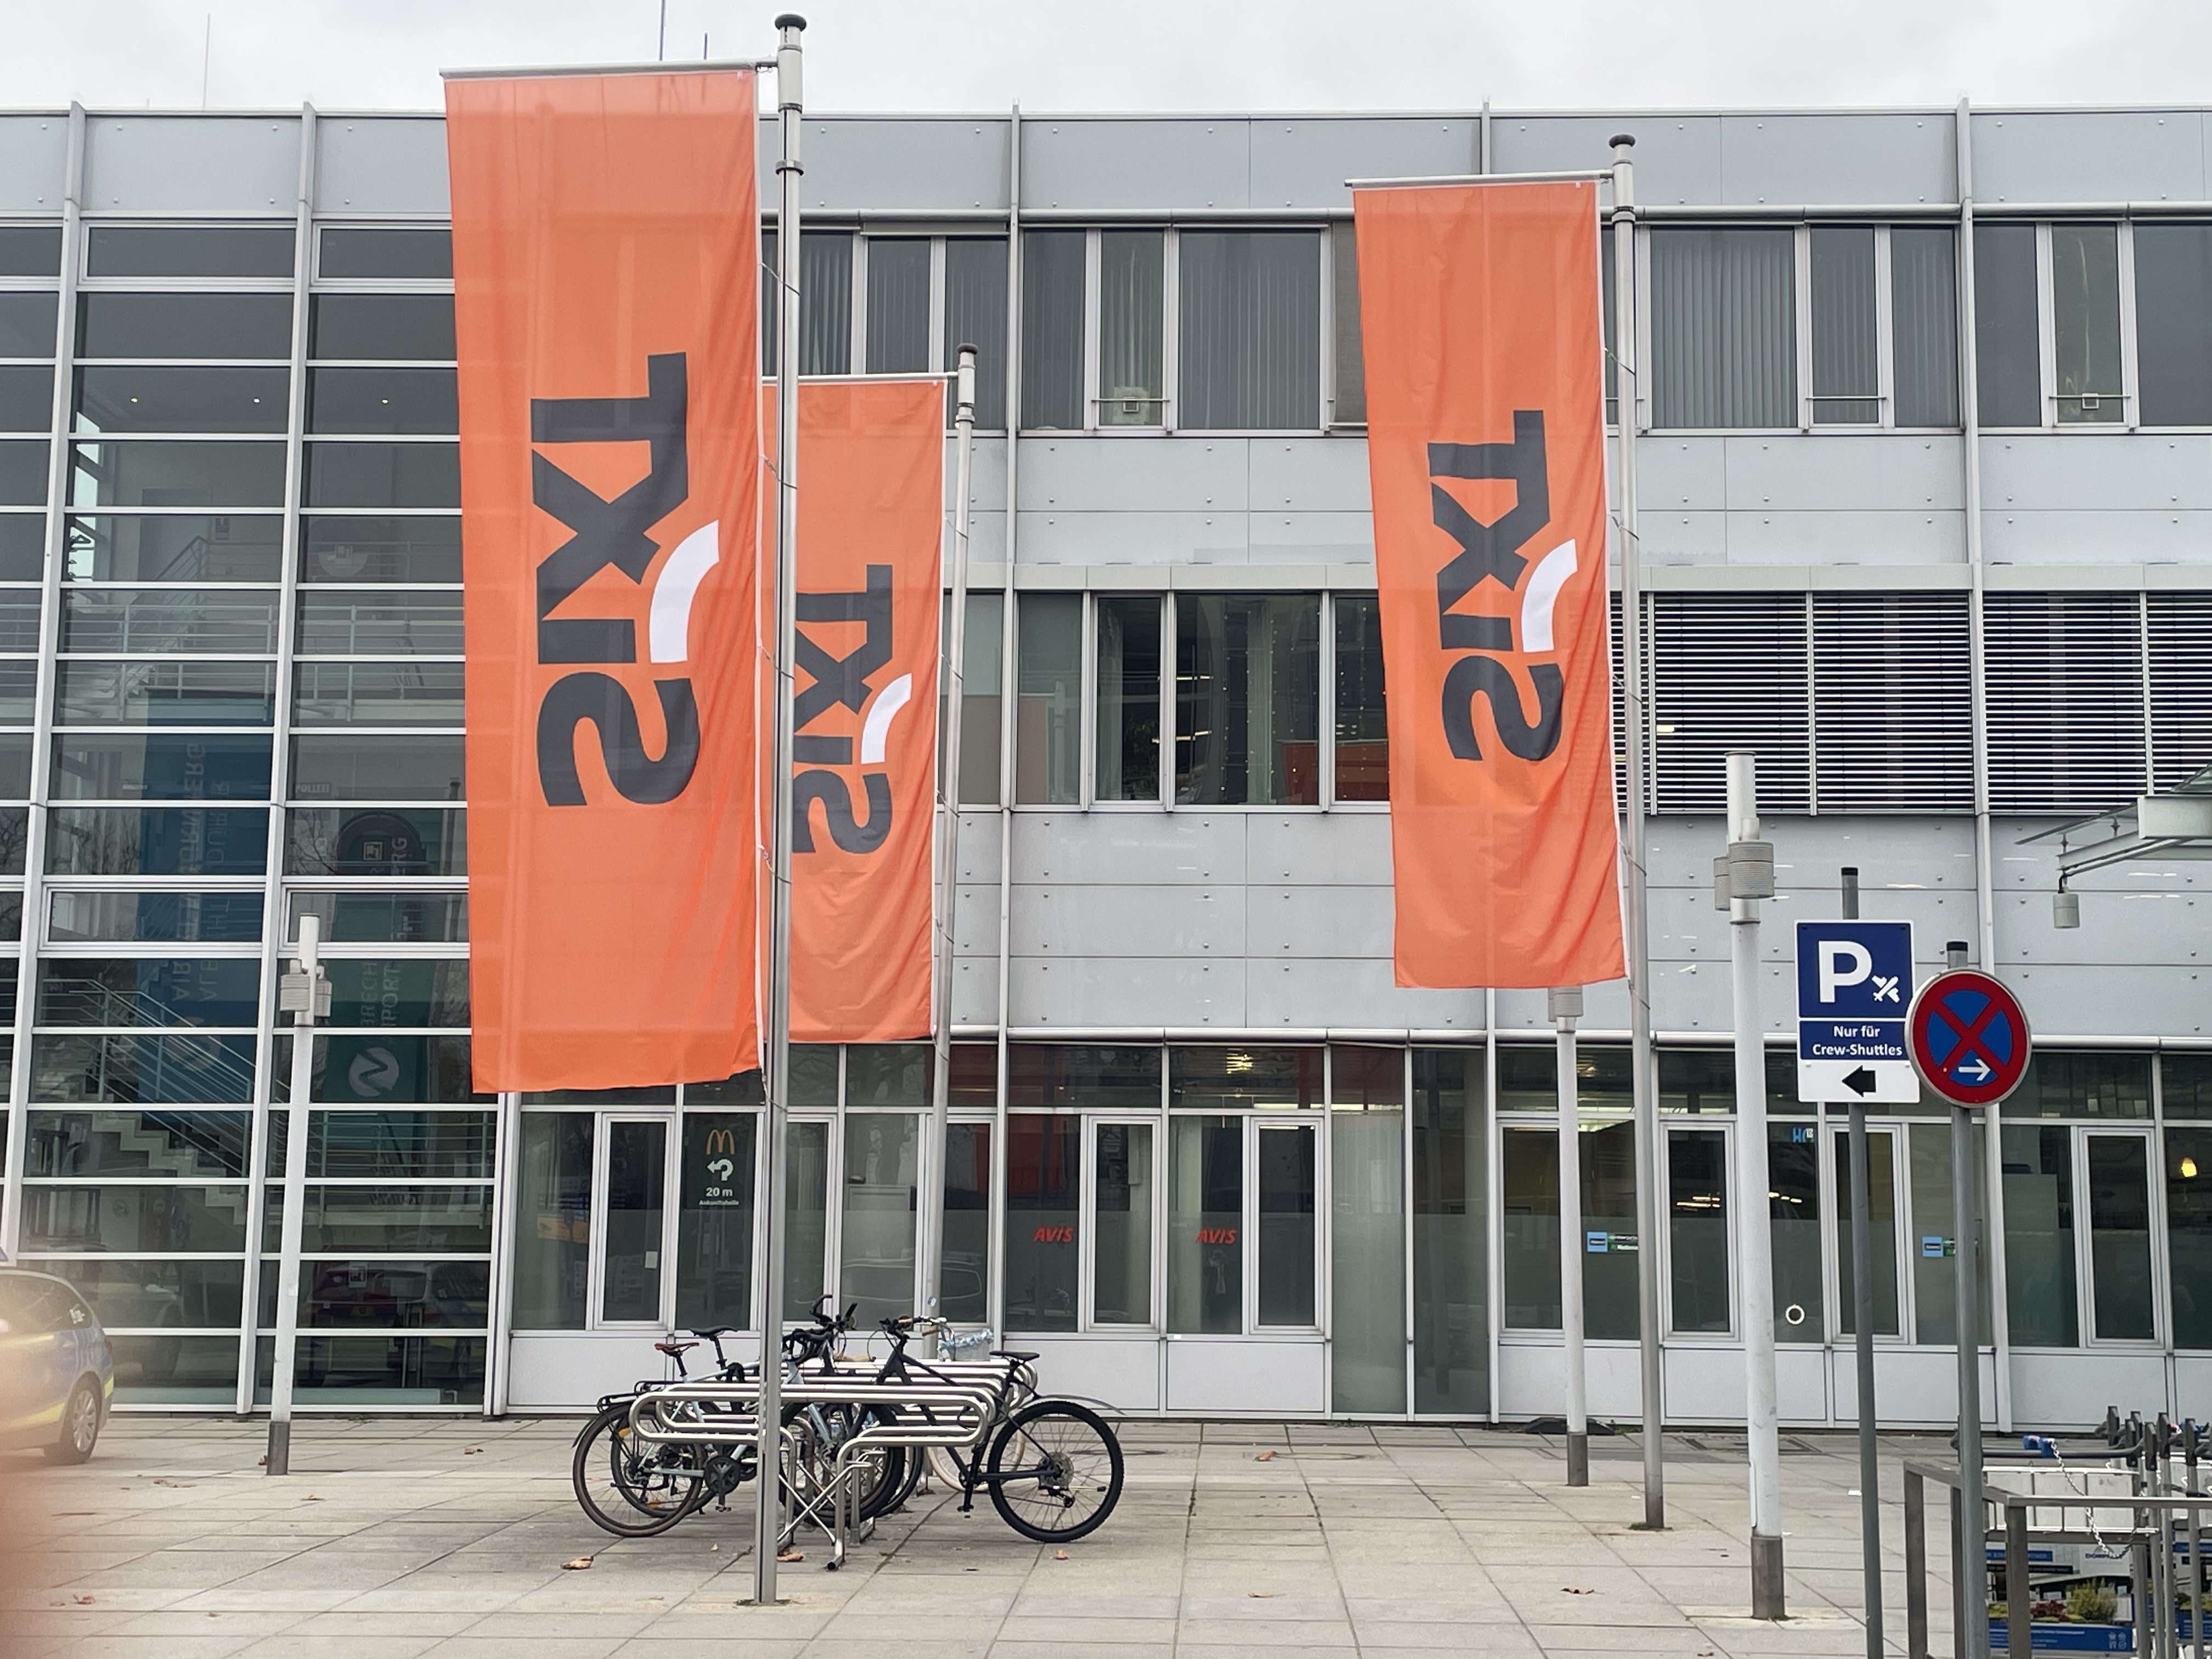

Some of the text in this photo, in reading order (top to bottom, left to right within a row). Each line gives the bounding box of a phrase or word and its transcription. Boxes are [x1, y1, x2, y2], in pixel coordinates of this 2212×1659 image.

[1819, 940, 1872, 1003] P
[1833, 1025, 1881, 1037] Nur für
[1812, 1044, 1903, 1056] Crew-Shuttles
[706, 1187, 733, 1197] 20 m
[1032, 1225, 1074, 1243] AVIS
[1195, 1228, 1237, 1245] AVIS
